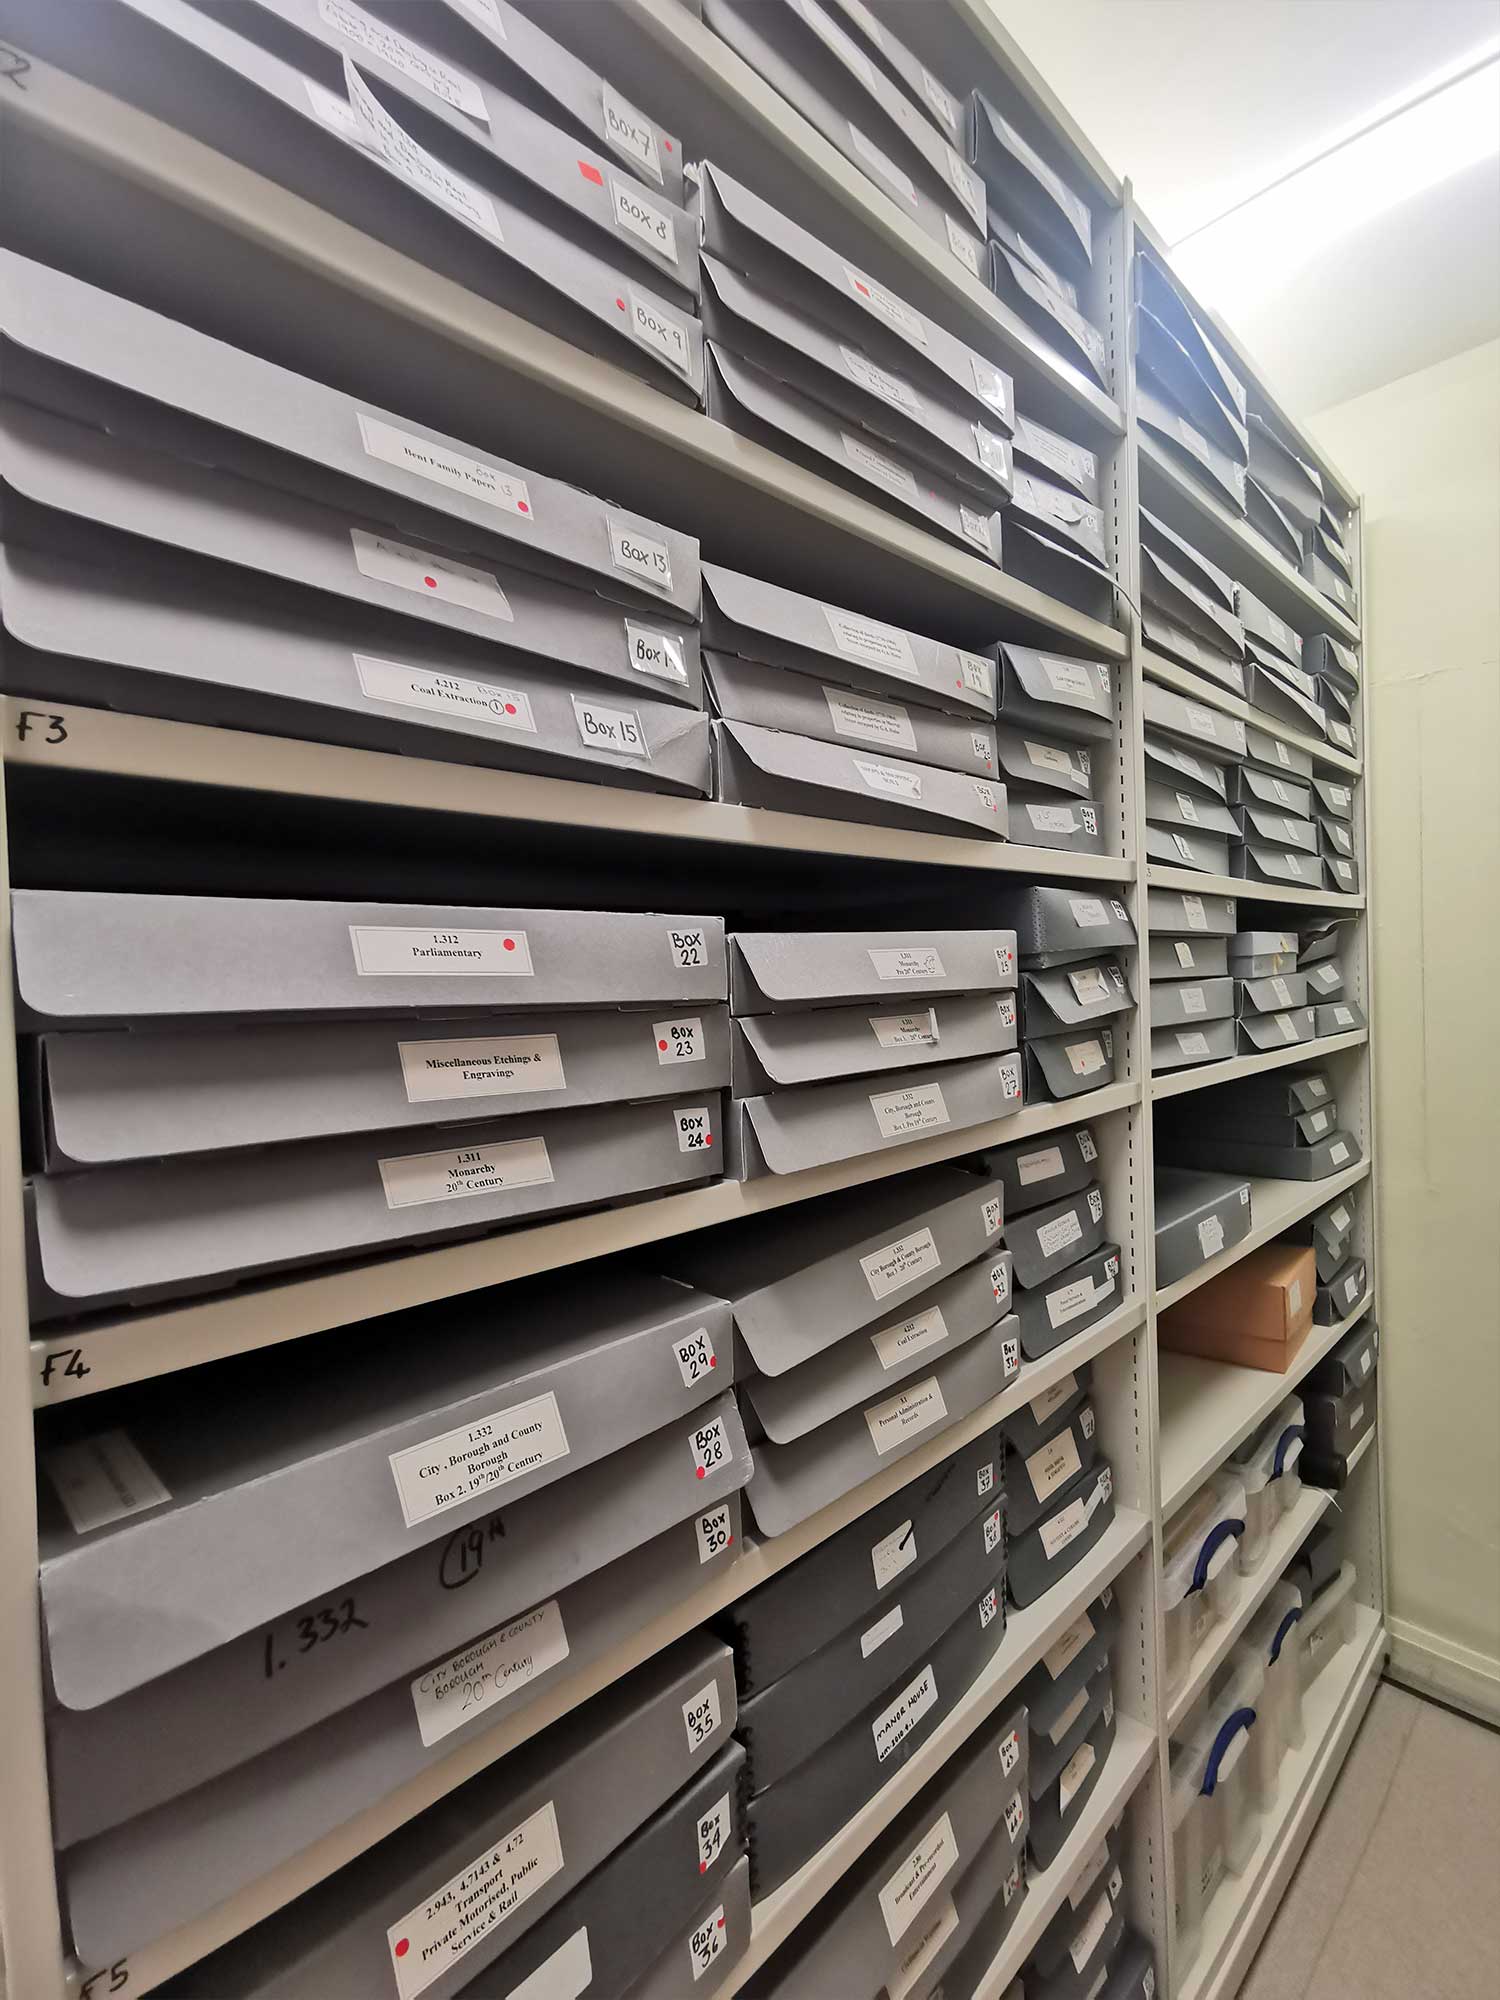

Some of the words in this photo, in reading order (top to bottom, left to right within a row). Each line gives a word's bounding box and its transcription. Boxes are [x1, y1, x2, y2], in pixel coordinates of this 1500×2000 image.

[620, 196, 651, 229] BOX
[657, 221, 667, 240] 8
[673, 330, 682, 350] 9
[430, 453, 463, 479] Family
[465, 472, 496, 492] Papers
[653, 552, 667, 573] 13
[411, 683, 436, 697] Coal
[438, 689, 488, 708] Extraction
[16, 711, 69, 746] F3
[620, 721, 637, 743] 15
[433, 934, 460, 945] 1.312
[413, 946, 483, 960] Parliamentary
[680, 947, 702, 966] 22
[425, 1055, 491, 1069] Miscellaneous
[494, 1053, 532, 1067] Etchings
[533, 1053, 542, 1063] &
[676, 1041, 694, 1057] 23
[463, 1067, 514, 1081] Engravings
[687, 1133, 704, 1148] 24
[448, 1162, 496, 1178] Monarchy
[457, 1152, 481, 1163] 1.311
[446, 1179, 464, 1193] 20th
[467, 1175, 504, 1191] Century
[41, 1349, 90, 1386] F4
[690, 1352, 709, 1379] 29
[469, 1425, 493, 1443] 1.332
[419, 1464, 441, 1479] City
[449, 1443, 490, 1467] Borough
[492, 1434, 509, 1448] and
[511, 1421, 543, 1440] County
[467, 1450, 508, 1474] Borough
[702, 1441, 723, 1467] 28
[435, 1489, 456, 1506] Box
[508, 1451, 544, 1473] Century
[707, 1531, 727, 1553] 30
[452, 1639, 498, 1673] BOROUGH
[508, 1611, 545, 1639] COUNTY
[434, 1662, 484, 1700] BOROUGH
[494, 1654, 535, 1689] Century
[877, 1706, 906, 1741] MANOR
[908, 1680, 929, 1708] HOUSE
[694, 1713, 715, 1742] 35
[702, 1831, 722, 1860] 34
[460, 1861, 490, 1893] 4.7143
[492, 1852, 501, 1866] &
[506, 1833, 524, 1854] 4.72
[455, 1869, 504, 1913] Transport
[421, 1929, 458, 1961] Private
[510, 1857, 539, 1885] Public
[451, 1921, 486, 1954] Service
[488, 1910, 497, 1925] &
[499, 1891, 518, 1914] Rail
[698, 1939, 719, 1968] 36
